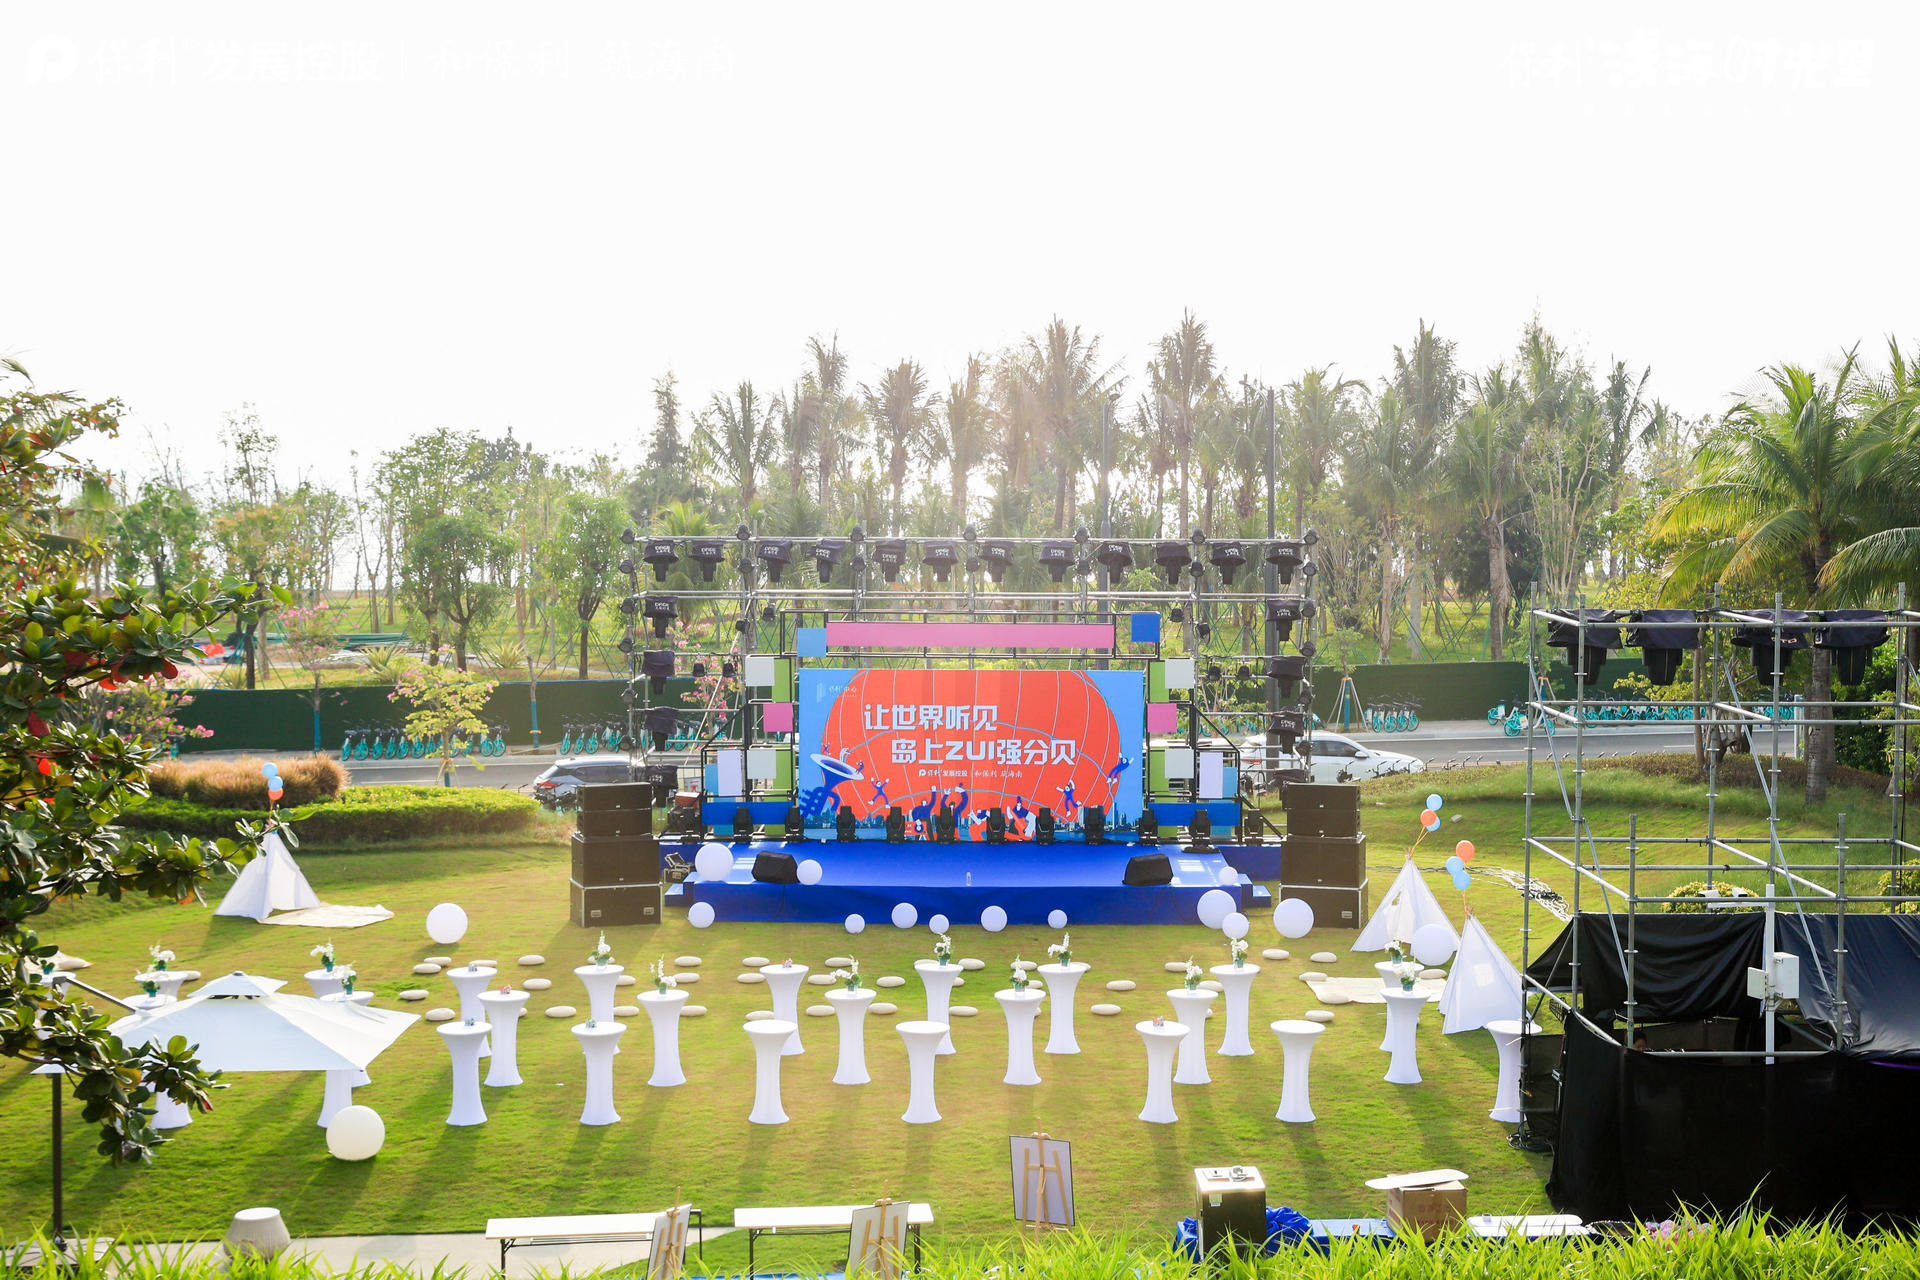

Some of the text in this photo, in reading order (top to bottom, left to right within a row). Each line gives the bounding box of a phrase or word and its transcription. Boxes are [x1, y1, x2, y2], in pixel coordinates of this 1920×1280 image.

[864, 703, 998, 731] 让世界听见
[891, 738, 1076, 765] 岛上ZUI强分贝
